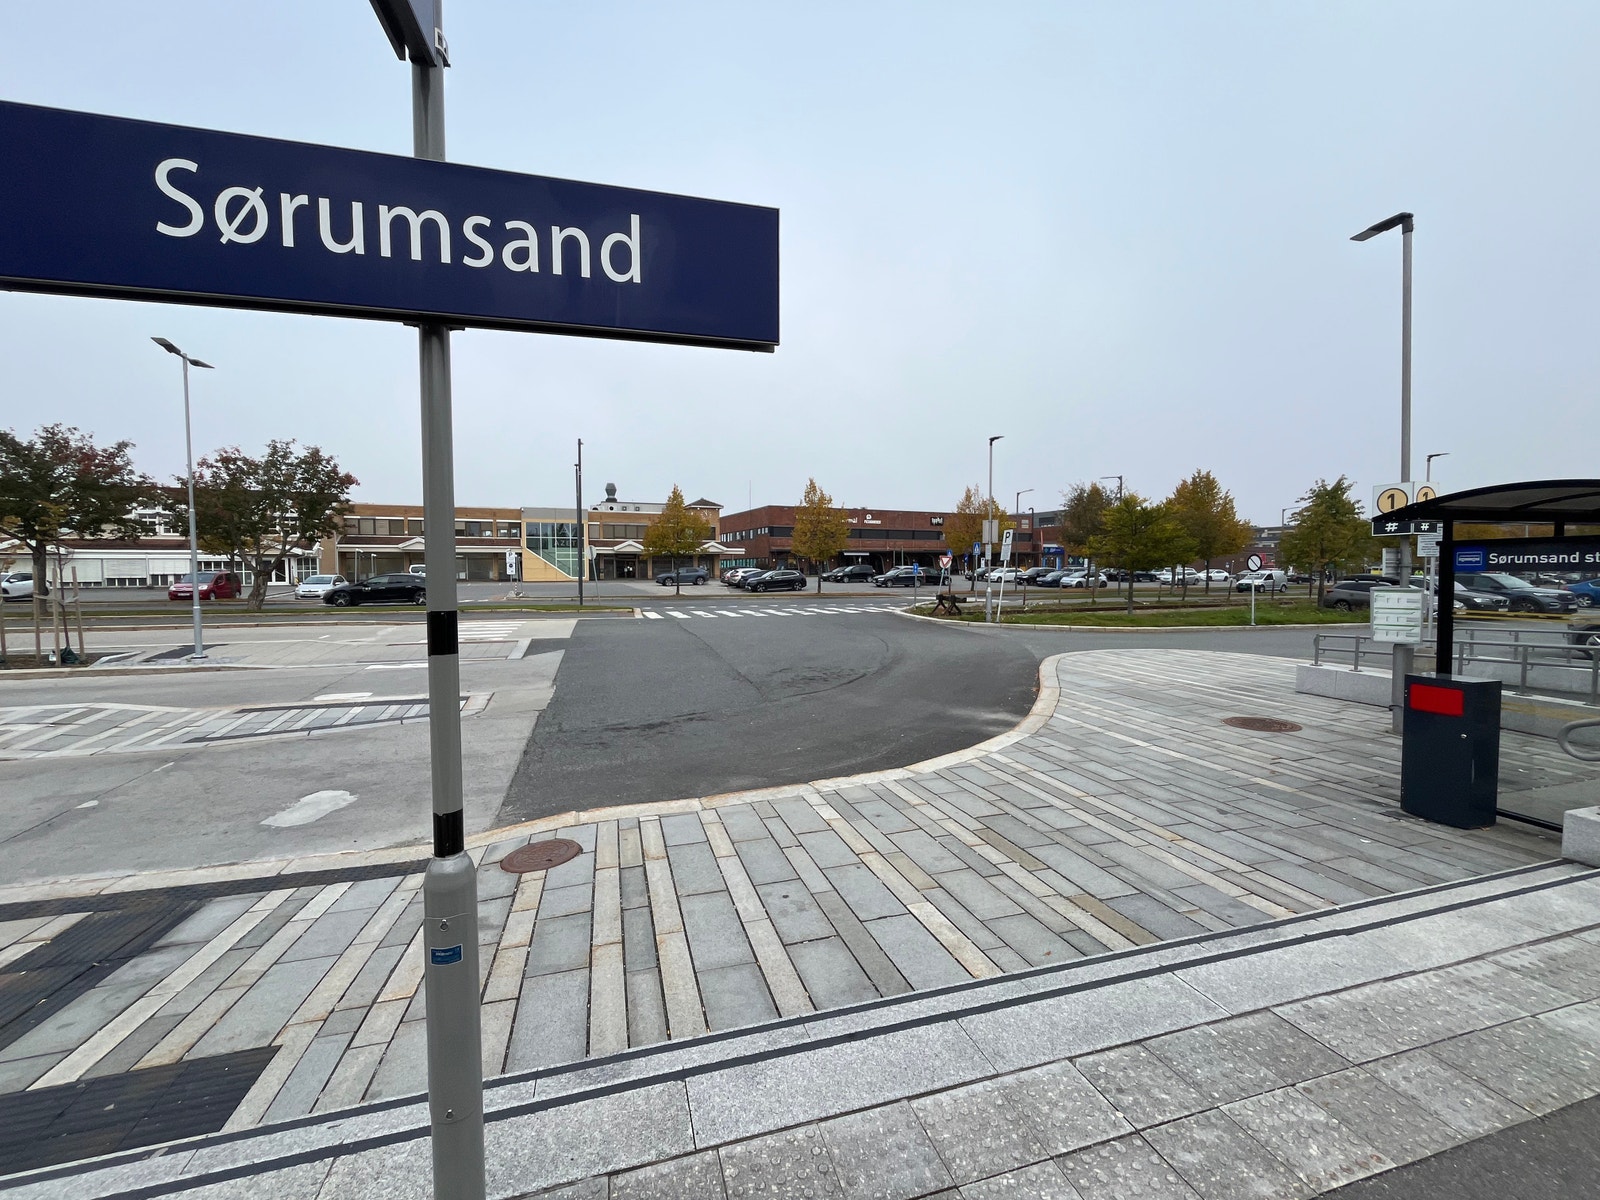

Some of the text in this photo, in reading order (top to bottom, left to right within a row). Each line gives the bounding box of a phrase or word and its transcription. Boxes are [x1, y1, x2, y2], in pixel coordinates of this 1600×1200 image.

[154, 157, 643, 284] Sørumsand
[1387, 493, 1395, 510] 1
[1004, 531, 1011, 543] P
[1488, 551, 1580, 564] Sørumsand
